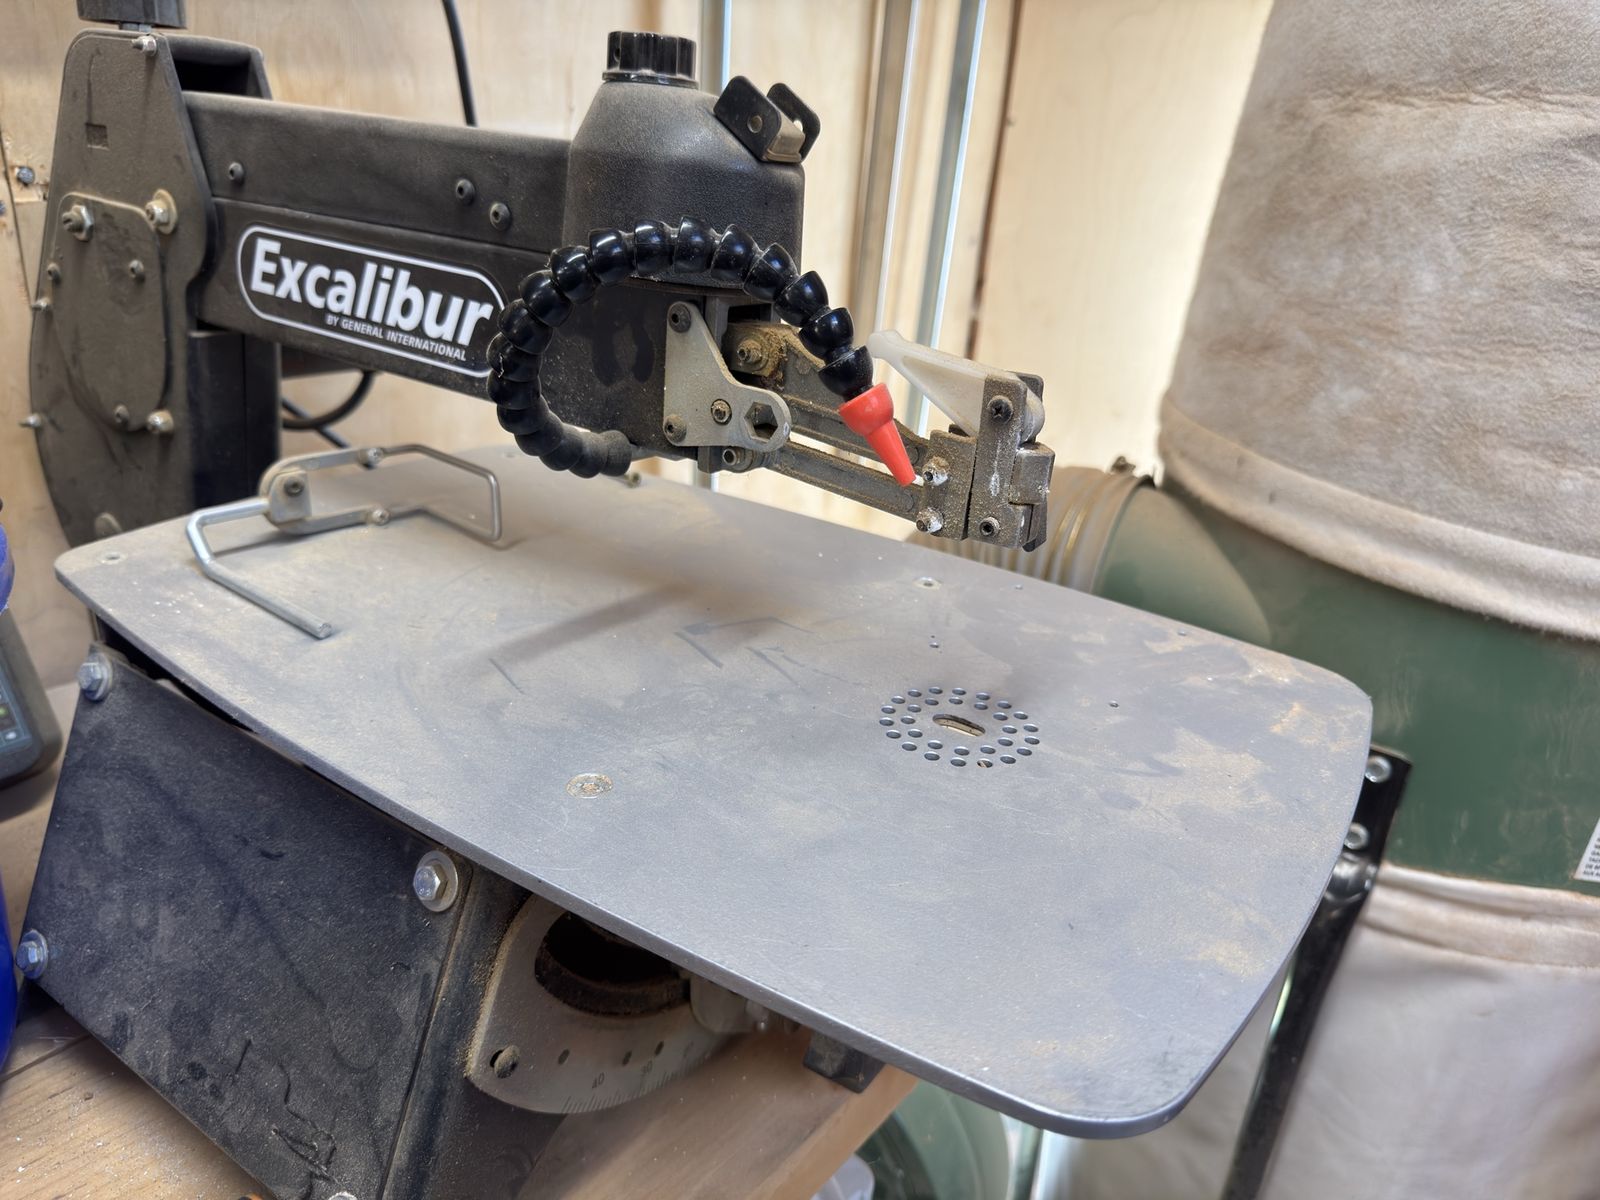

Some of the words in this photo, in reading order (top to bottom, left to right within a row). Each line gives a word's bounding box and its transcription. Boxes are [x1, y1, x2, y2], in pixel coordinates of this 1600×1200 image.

[251, 237, 494, 346] Excalibur
[326, 314, 339, 327] BY
[341, 318, 384, 339] GENERAL
[386, 330, 467, 361] INTERNATIONAL
[592, 1072, 605, 1089] 40
